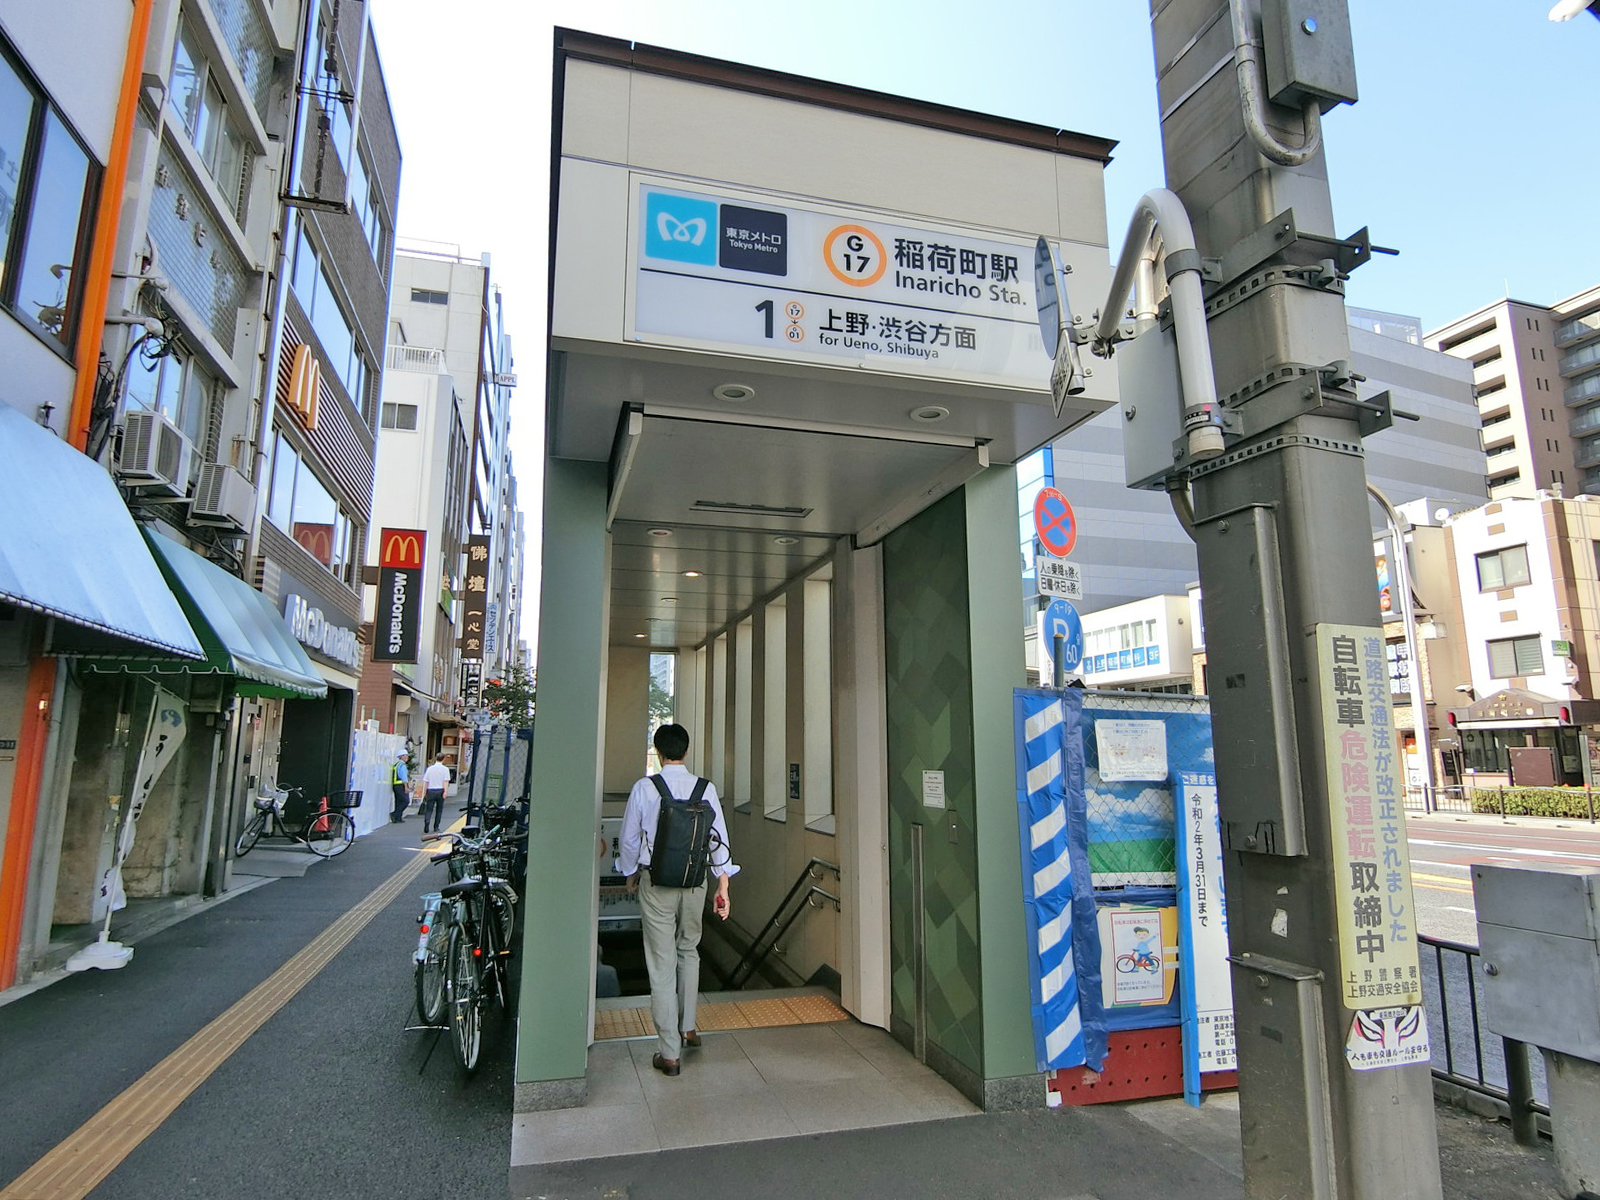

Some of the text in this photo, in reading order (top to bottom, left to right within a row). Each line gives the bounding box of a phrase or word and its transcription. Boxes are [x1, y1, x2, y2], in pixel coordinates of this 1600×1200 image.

[725, 226, 782, 245] 東京メトロ
[846, 234, 864, 252] G
[728, 239, 778, 254] Tokyo Metro
[843, 253, 871, 273] 17
[893, 238, 1020, 284] 稲荷町駅
[895, 270, 1027, 306] Inaricho Sta.
[754, 299, 775, 339] 1
[789, 308, 801, 317] 17
[788, 330, 800, 340] 01
[819, 333, 939, 360] for Ueno, Shibuya
[1040, 561, 1080, 580] 人の乗降を除く
[388, 571, 409, 655] McDonald's
[1054, 603, 1073, 616] 9-19
[1066, 643, 1078, 664] 60
[1148, 650, 1160, 661] 3F
[1331, 634, 1385, 964] 自転車危険運転取締中
[1363, 636, 1409, 943] 道路交通法が改正されました
[1191, 793, 1209, 927] 令和2年3月31日まで
[1347, 980, 1419, 998] 上野交通安全協会
